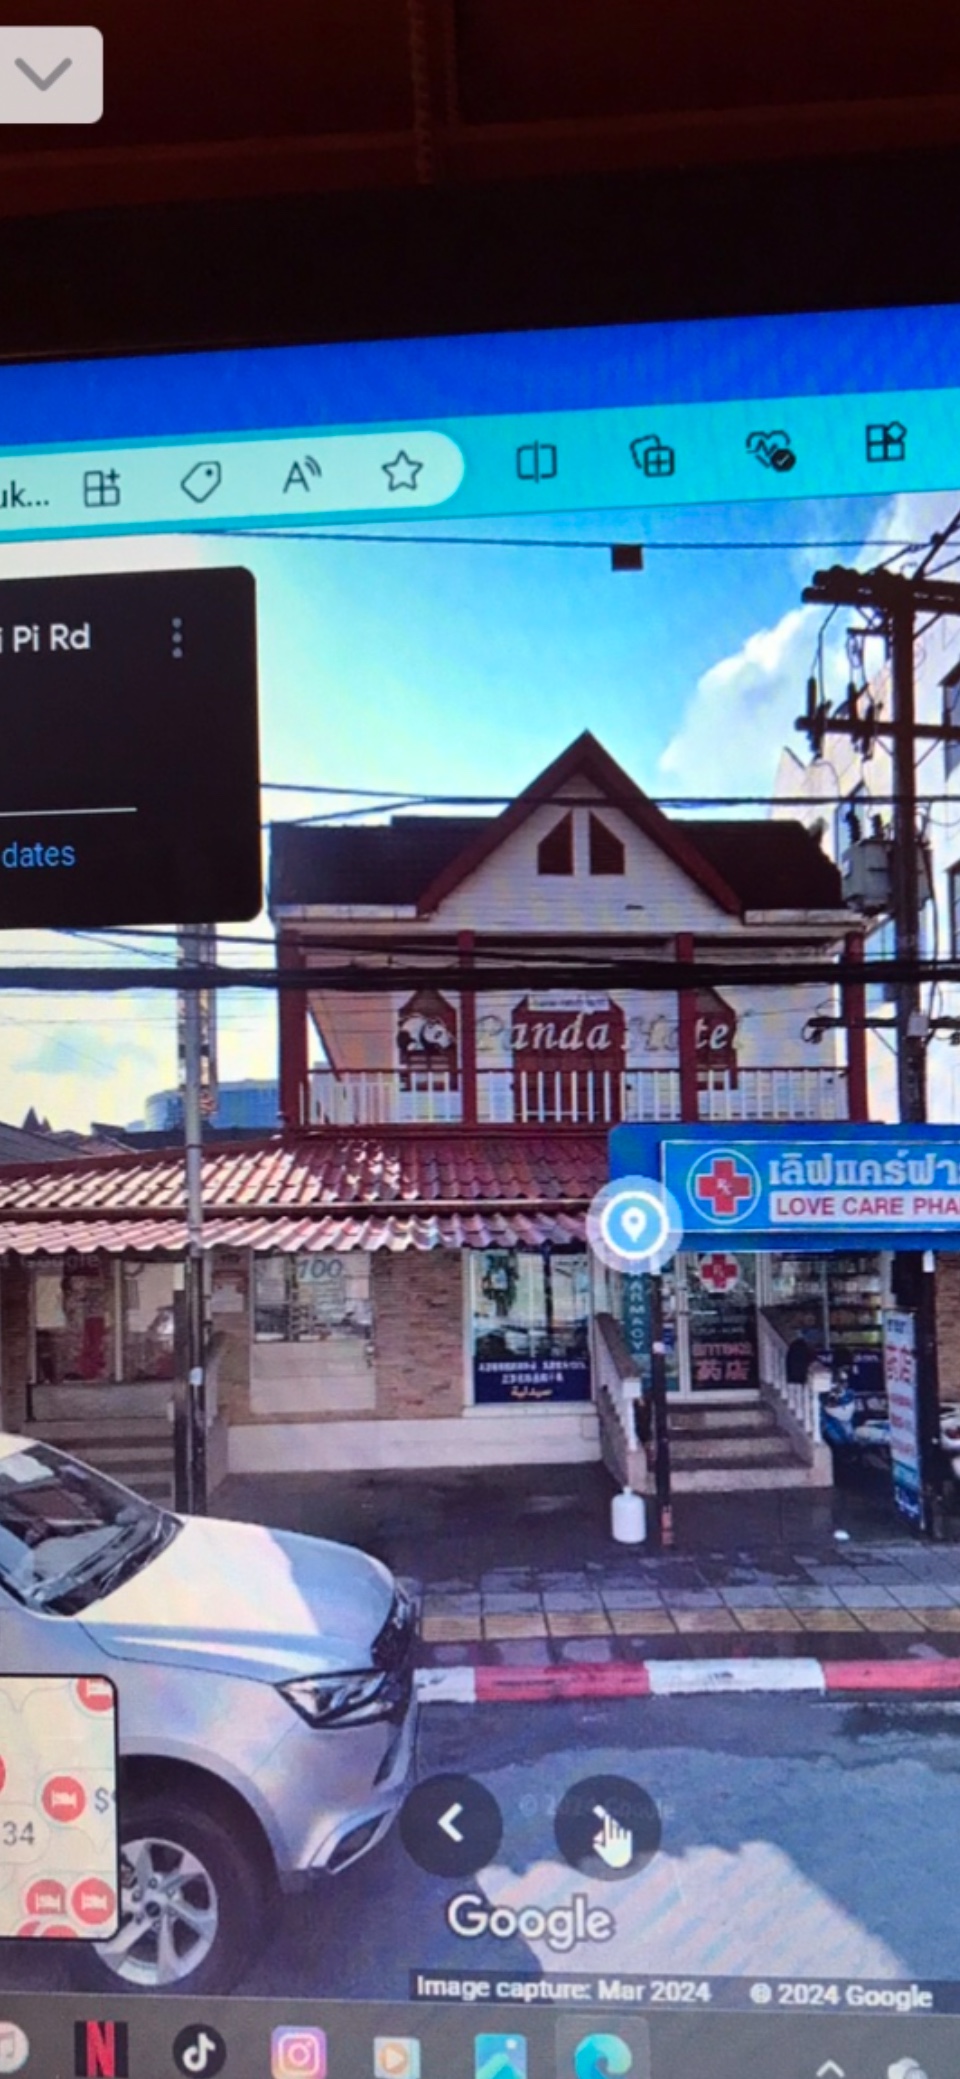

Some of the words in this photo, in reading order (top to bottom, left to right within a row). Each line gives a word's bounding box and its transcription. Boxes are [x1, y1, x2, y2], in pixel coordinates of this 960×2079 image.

[12, 622, 40, 653] Pi
[50, 622, 91, 651] Rd
[1, 840, 77, 869] dates
[475, 1012, 613, 1052] Panda
[768, 1148, 960, 1187] เลิฟแคร์ฟา
[776, 1197, 835, 1216] LOVE
[842, 1197, 905, 1216] CARE
[912, 1198, 960, 1216] PHA
[448, 1894, 614, 1951] Google
[417, 1975, 490, 2001] Image
[496, 1979, 592, 2003] capture:
[597, 1979, 644, 2001] Mar
[650, 1981, 712, 2002] 2024
[777, 1983, 840, 2006] 2024
[845, 1983, 934, 2013] Google
